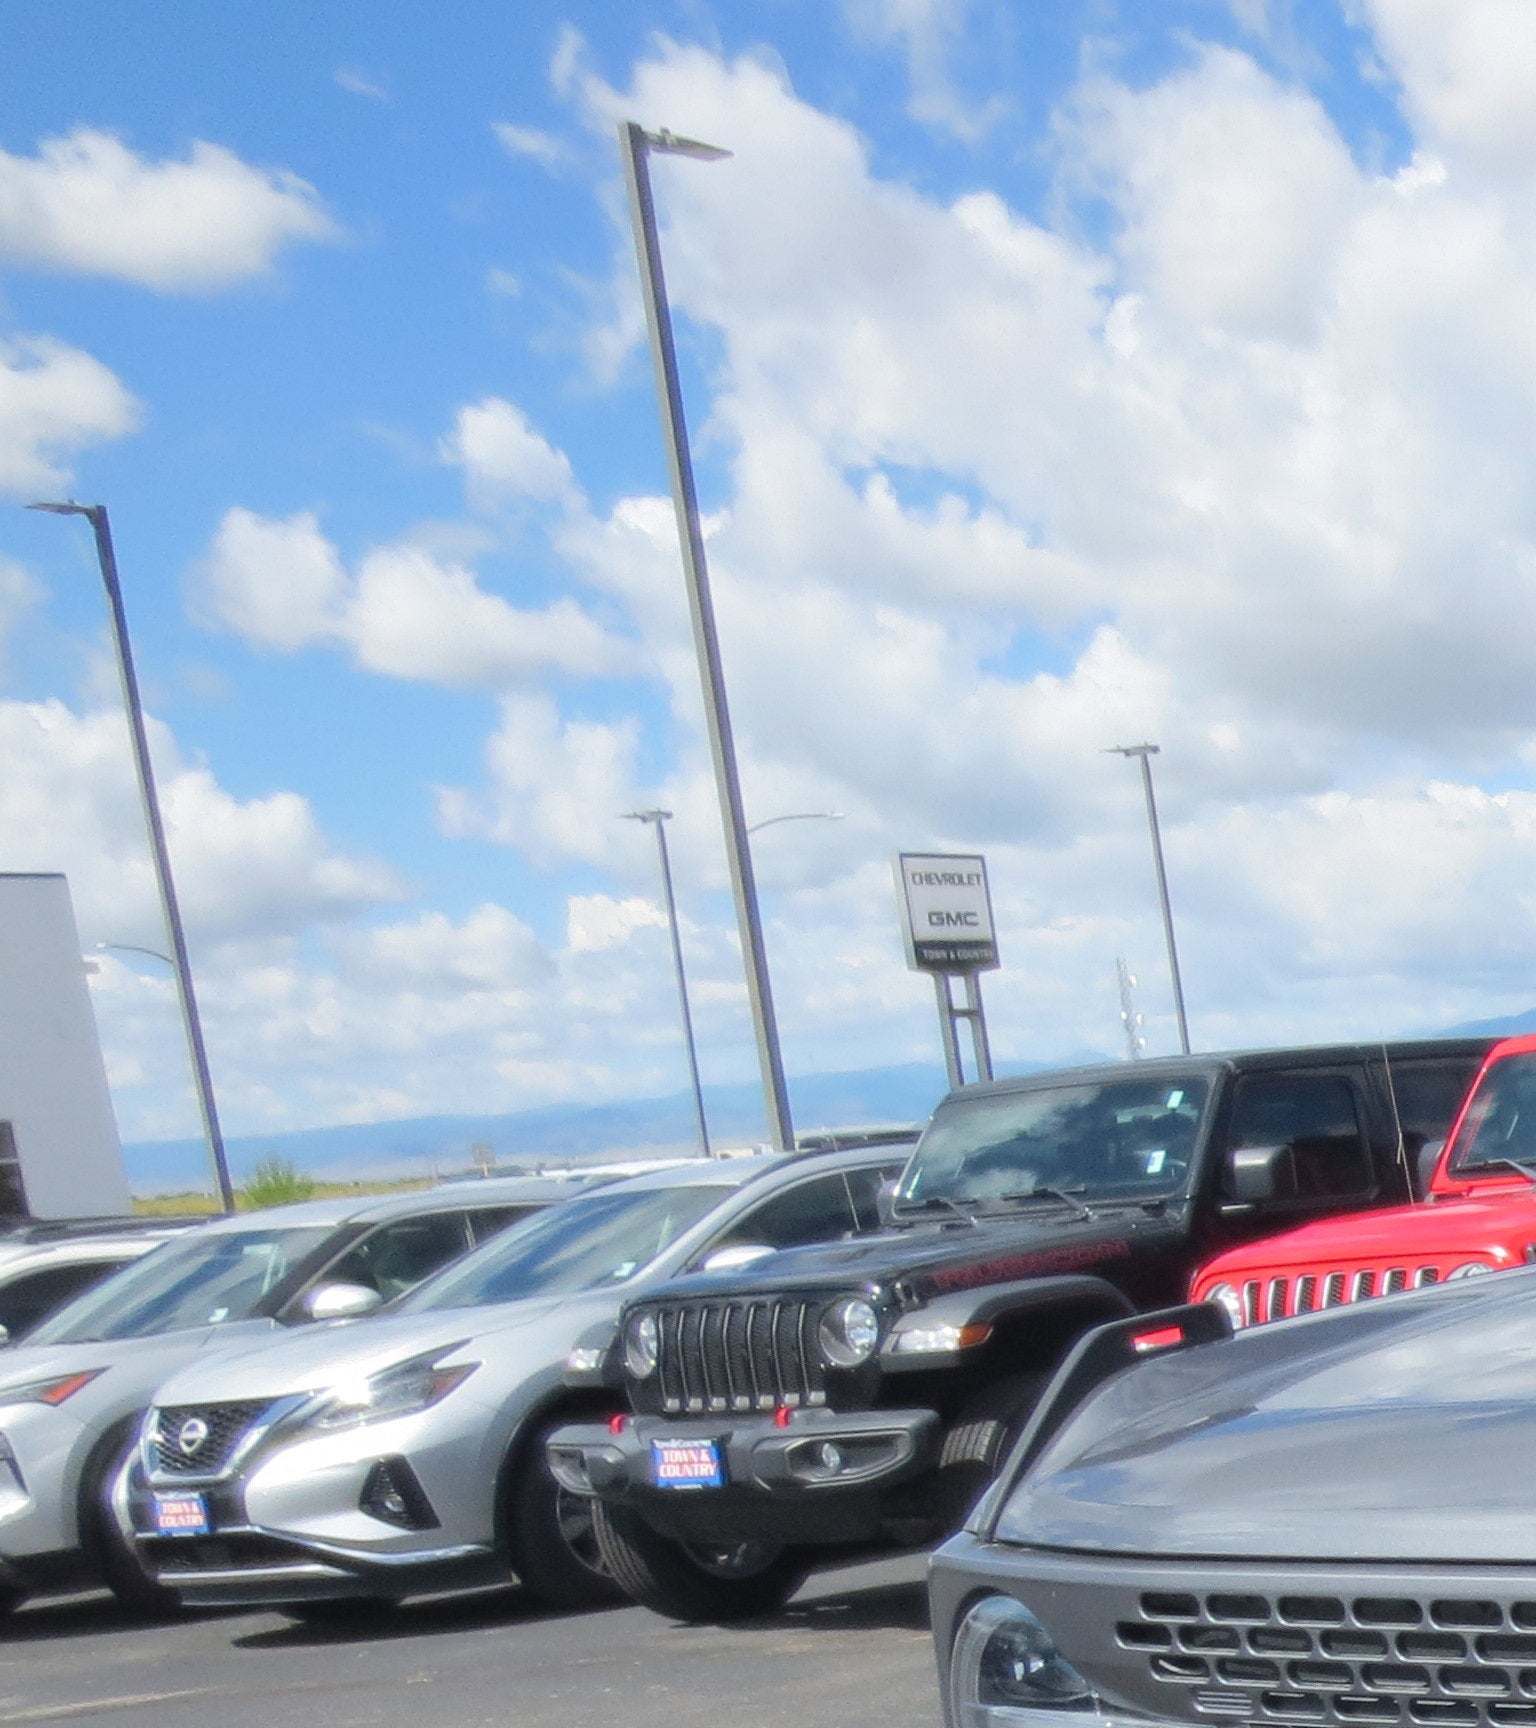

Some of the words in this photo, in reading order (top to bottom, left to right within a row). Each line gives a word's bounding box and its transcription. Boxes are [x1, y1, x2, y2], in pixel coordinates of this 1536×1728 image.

[911, 872, 983, 887] CHEVROLET
[928, 911, 979, 927] GMC
[662, 1449, 698, 1463] TOWN
[700, 1449, 711, 1462] &
[658, 1462, 718, 1478] COUNTRY
